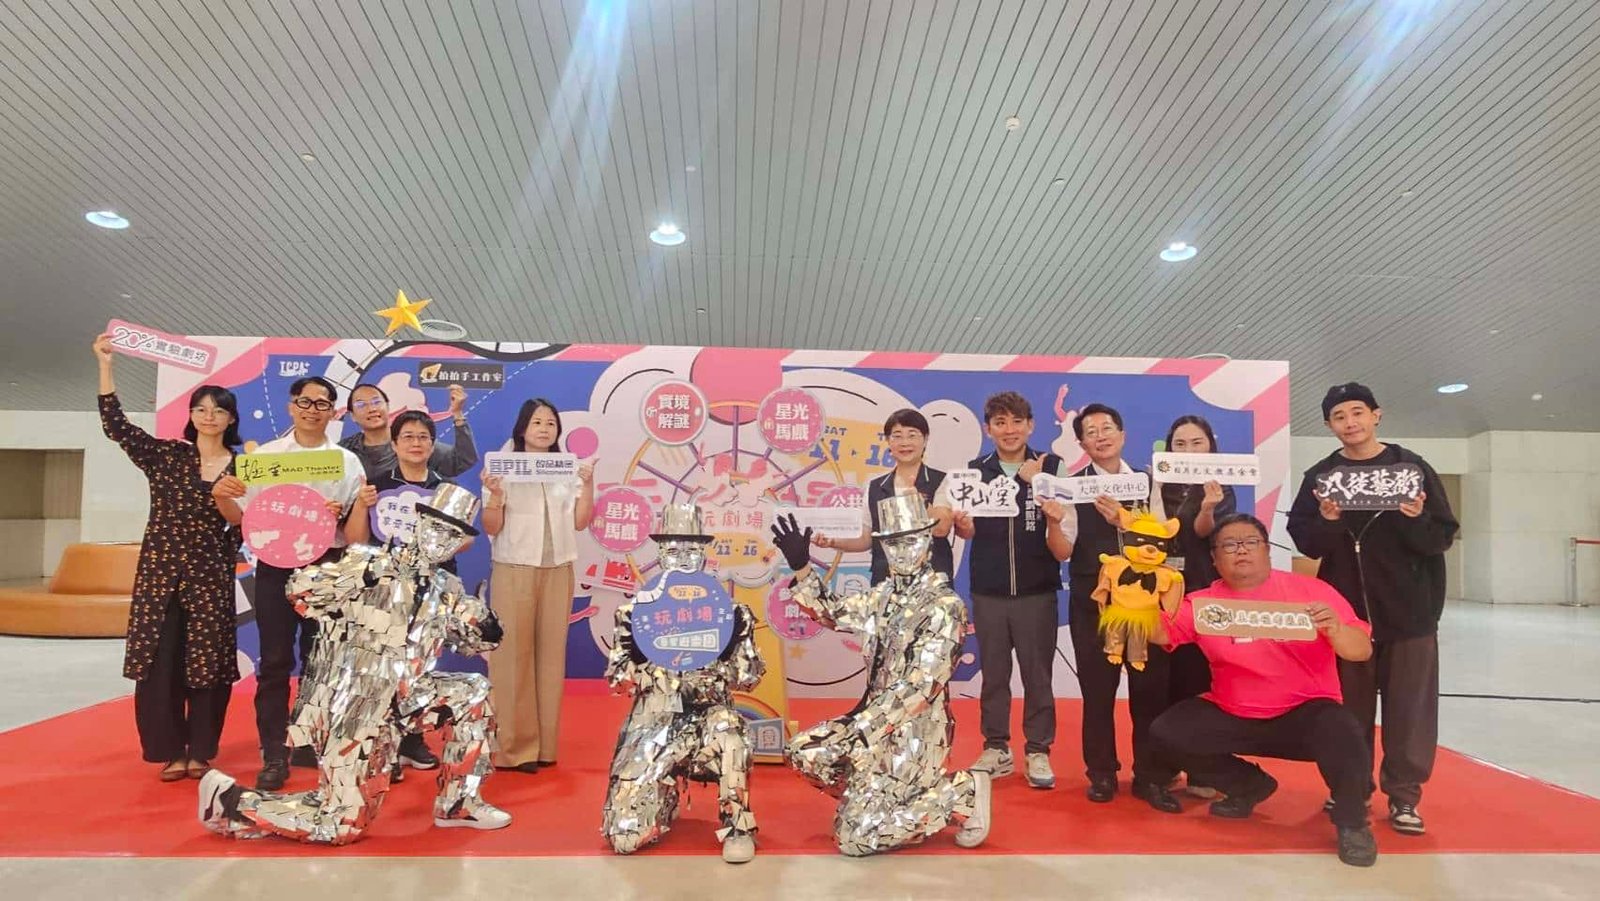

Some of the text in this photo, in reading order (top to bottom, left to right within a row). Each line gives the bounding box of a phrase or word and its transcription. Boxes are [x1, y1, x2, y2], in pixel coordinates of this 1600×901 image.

[658, 394, 690, 410] 實境
[776, 402, 809, 420] 星光
[658, 413, 690, 429] 解謎
[775, 423, 808, 441] 馬戲
[950, 477, 1016, 508] 中山堂
[606, 502, 639, 520] 星光
[604, 523, 638, 541] 馬戲
